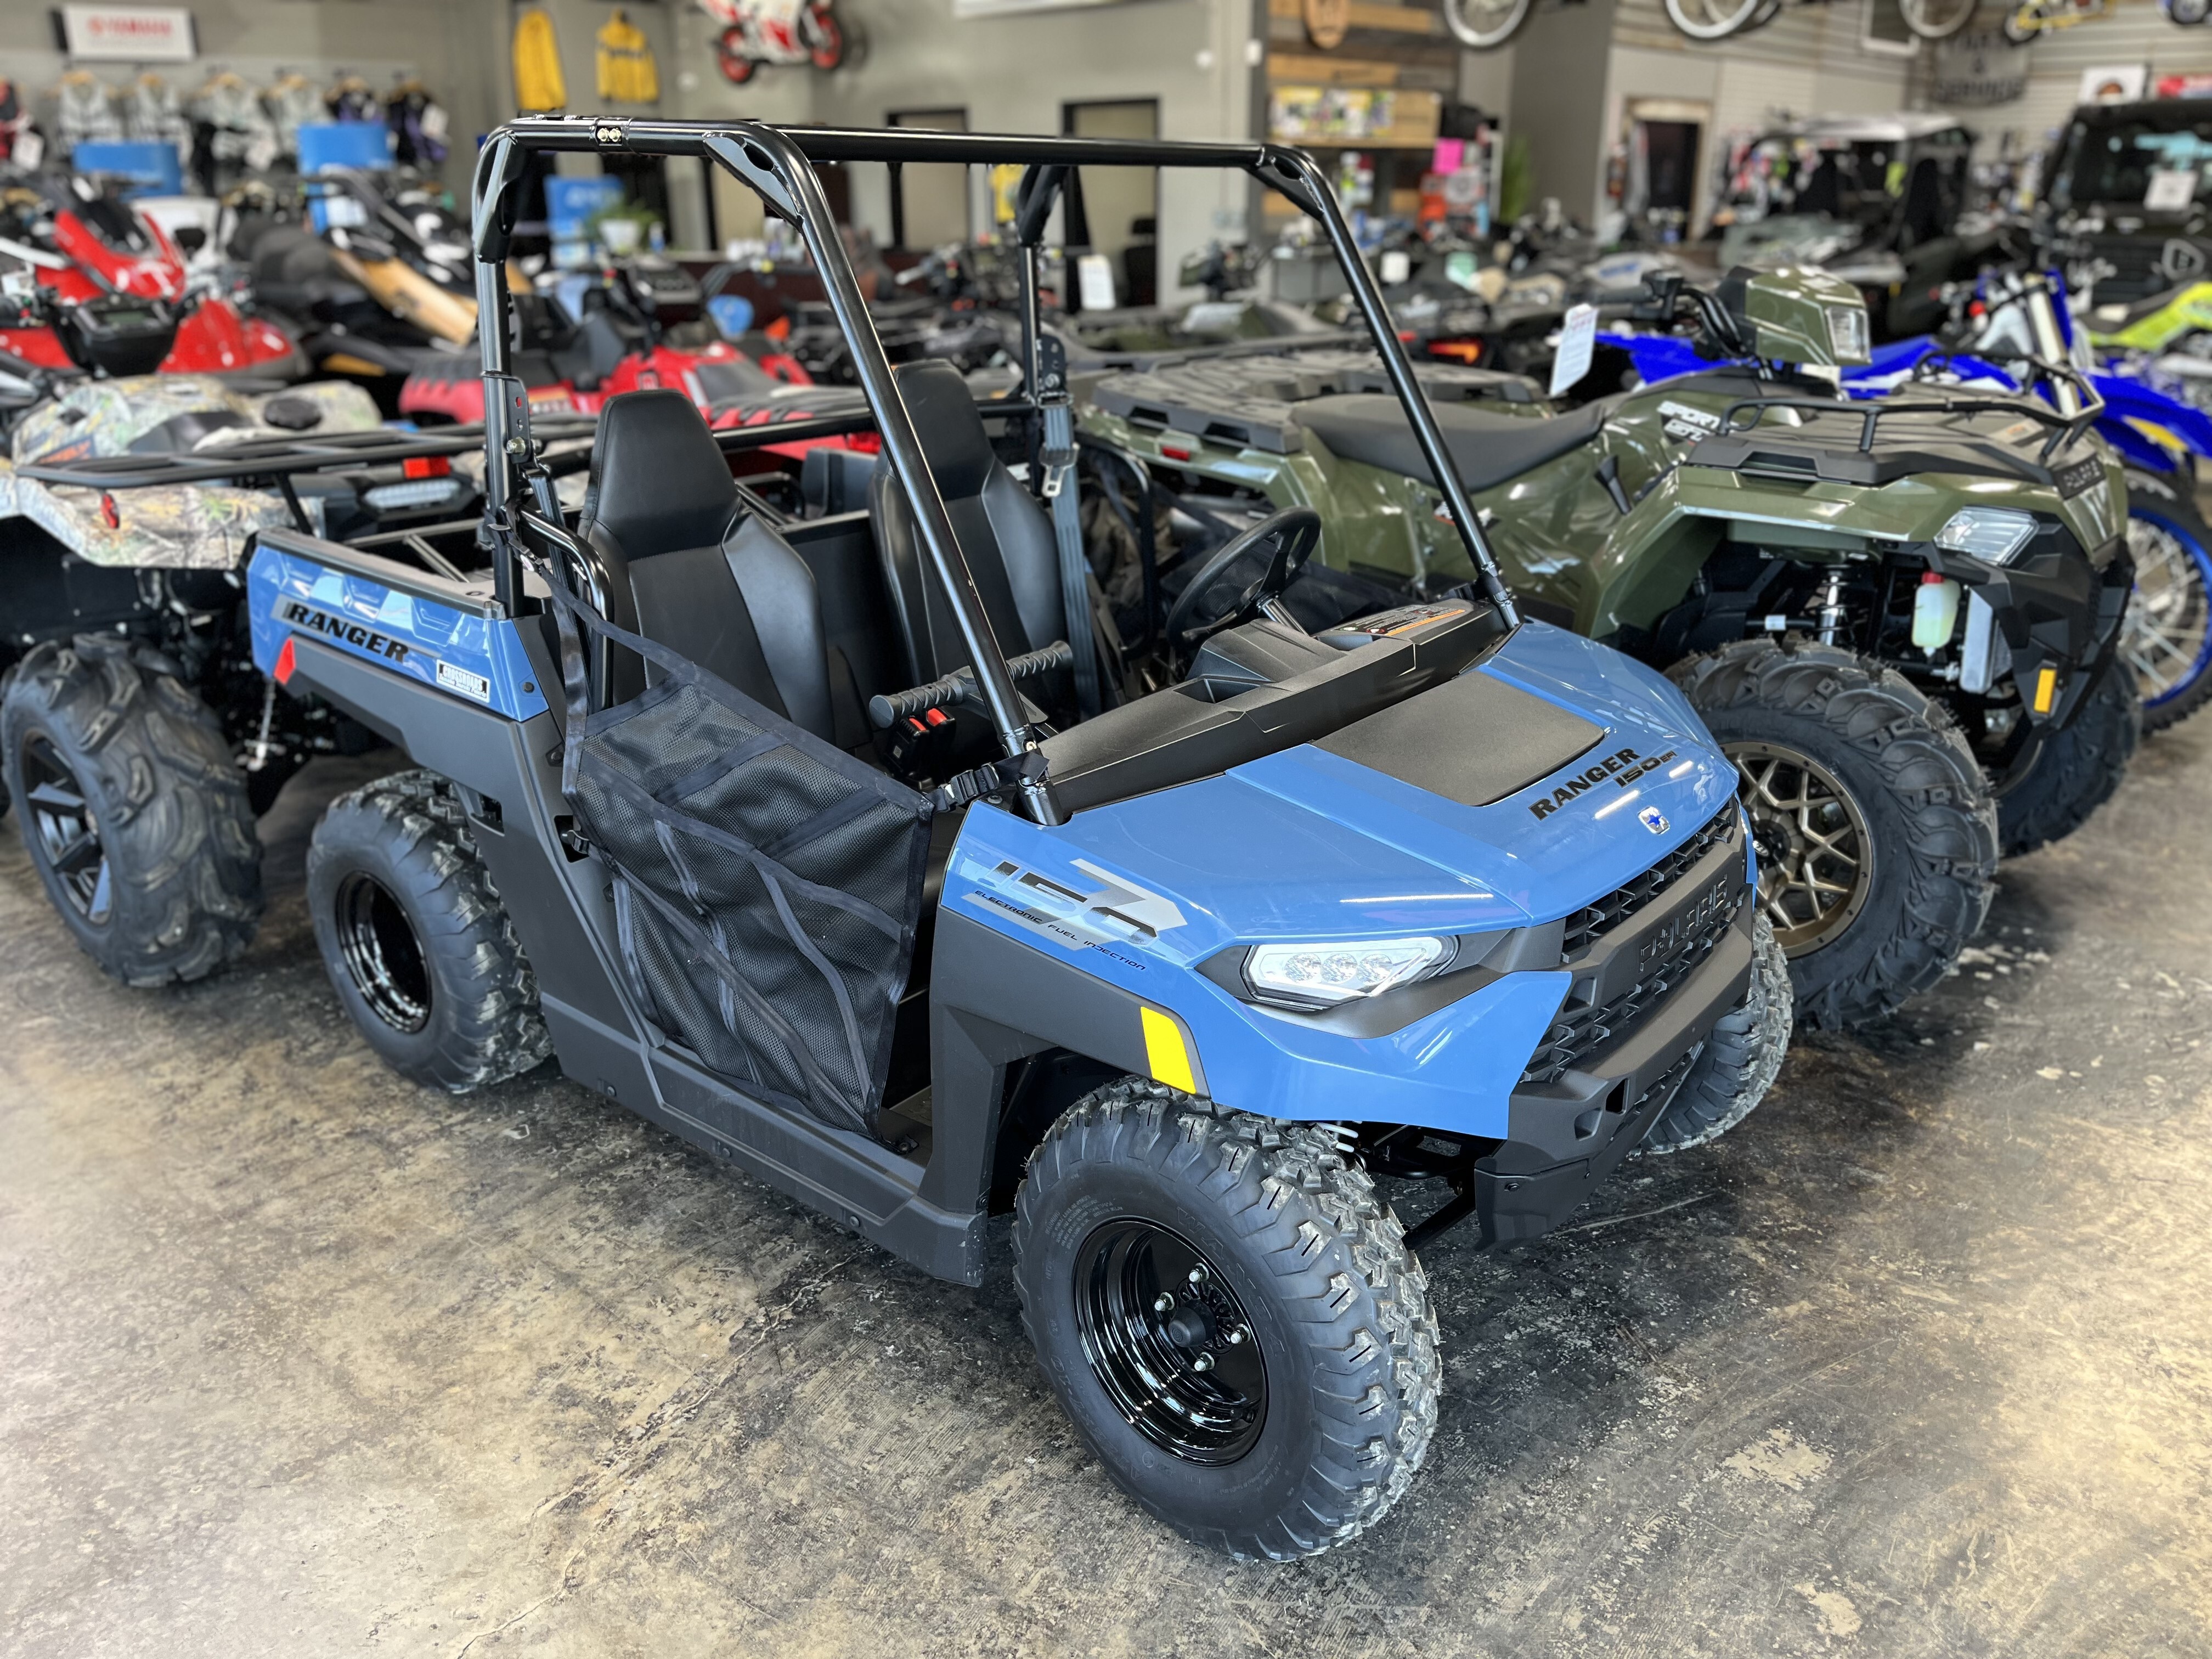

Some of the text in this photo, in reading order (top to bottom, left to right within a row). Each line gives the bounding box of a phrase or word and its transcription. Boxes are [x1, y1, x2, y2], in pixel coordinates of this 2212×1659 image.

[287, 601, 410, 664] RANGER
[442, 664, 483, 692] CROSSROADS
[1527, 747, 1641, 821] RANGER
[974, 889, 1147, 971] ELECTRONIC FUEL INJECTION
[1638, 872, 1728, 975] POLARIS
[1176, 1206, 1286, 1357] WANDA
